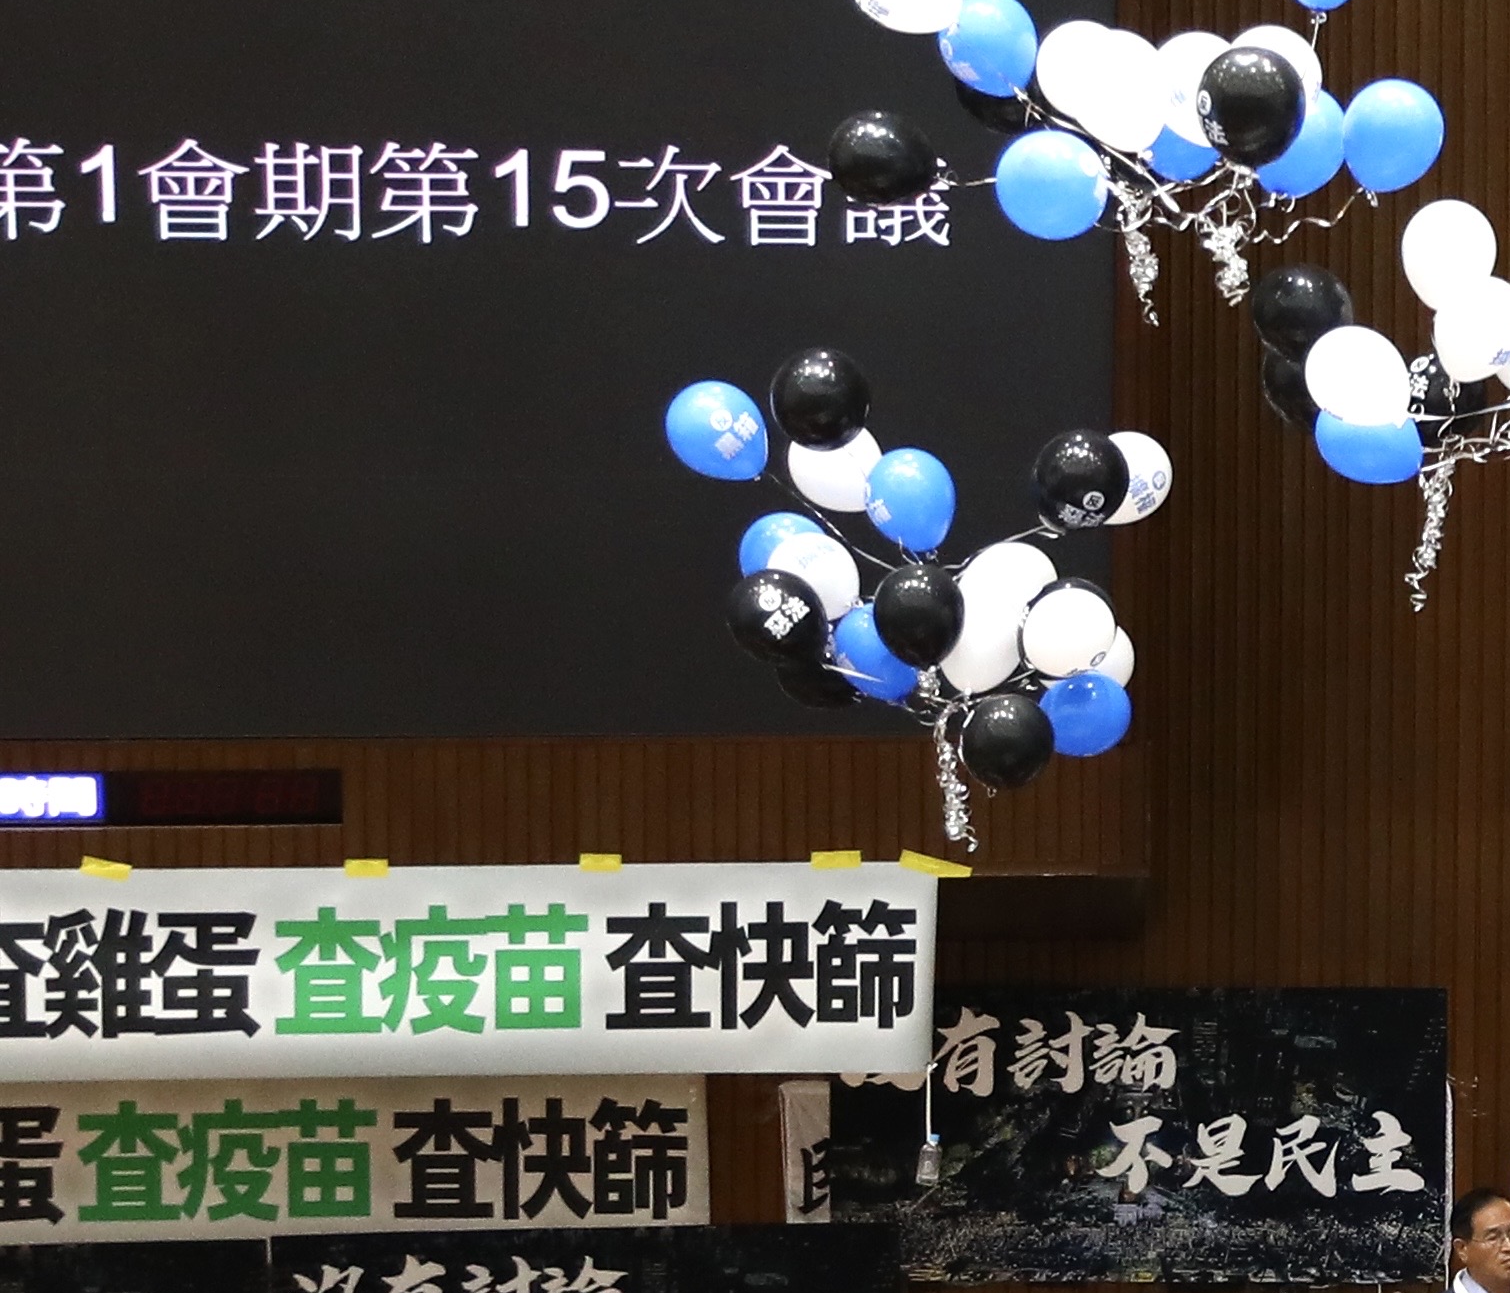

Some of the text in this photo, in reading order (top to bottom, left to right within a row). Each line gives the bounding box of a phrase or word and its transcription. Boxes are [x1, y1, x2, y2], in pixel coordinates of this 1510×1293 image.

[275, 904, 588, 1036] 查疫苗
[605, 900, 917, 1031] 查快篩
[842, 1011, 1179, 1098] 有討論
[78, 1100, 378, 1223] 查疫苗
[394, 1098, 688, 1222] 查快篩
[1098, 1112, 1428, 1198] 不是民主
